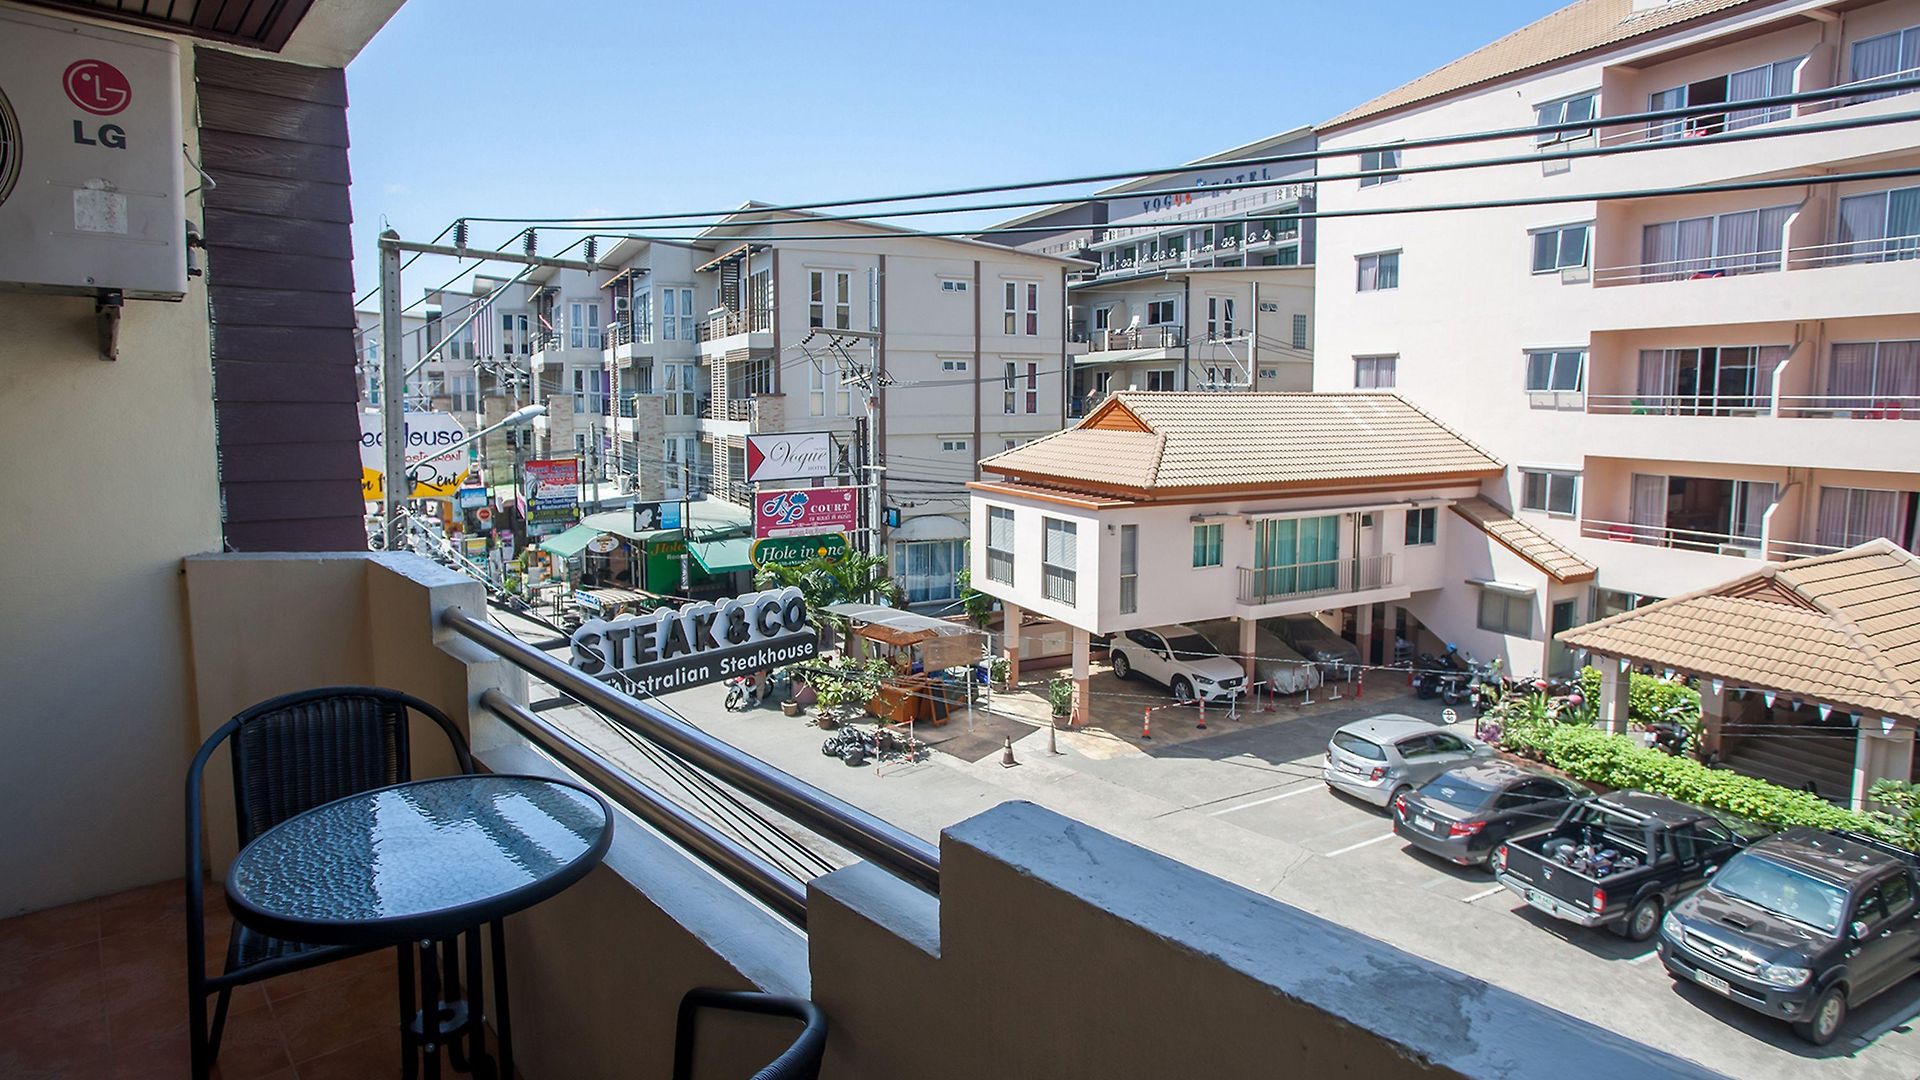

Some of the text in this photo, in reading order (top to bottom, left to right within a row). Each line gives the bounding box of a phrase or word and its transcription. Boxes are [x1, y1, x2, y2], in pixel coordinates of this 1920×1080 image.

[73, 119, 127, 150] LG
[405, 422, 464, 448] ouse
[770, 437, 827, 473] Vogue
[810, 503, 850, 513] COURT
[757, 545, 797, 564] Hole
[801, 545, 814, 558] in
[720, 640, 814, 675] Steakhouse
